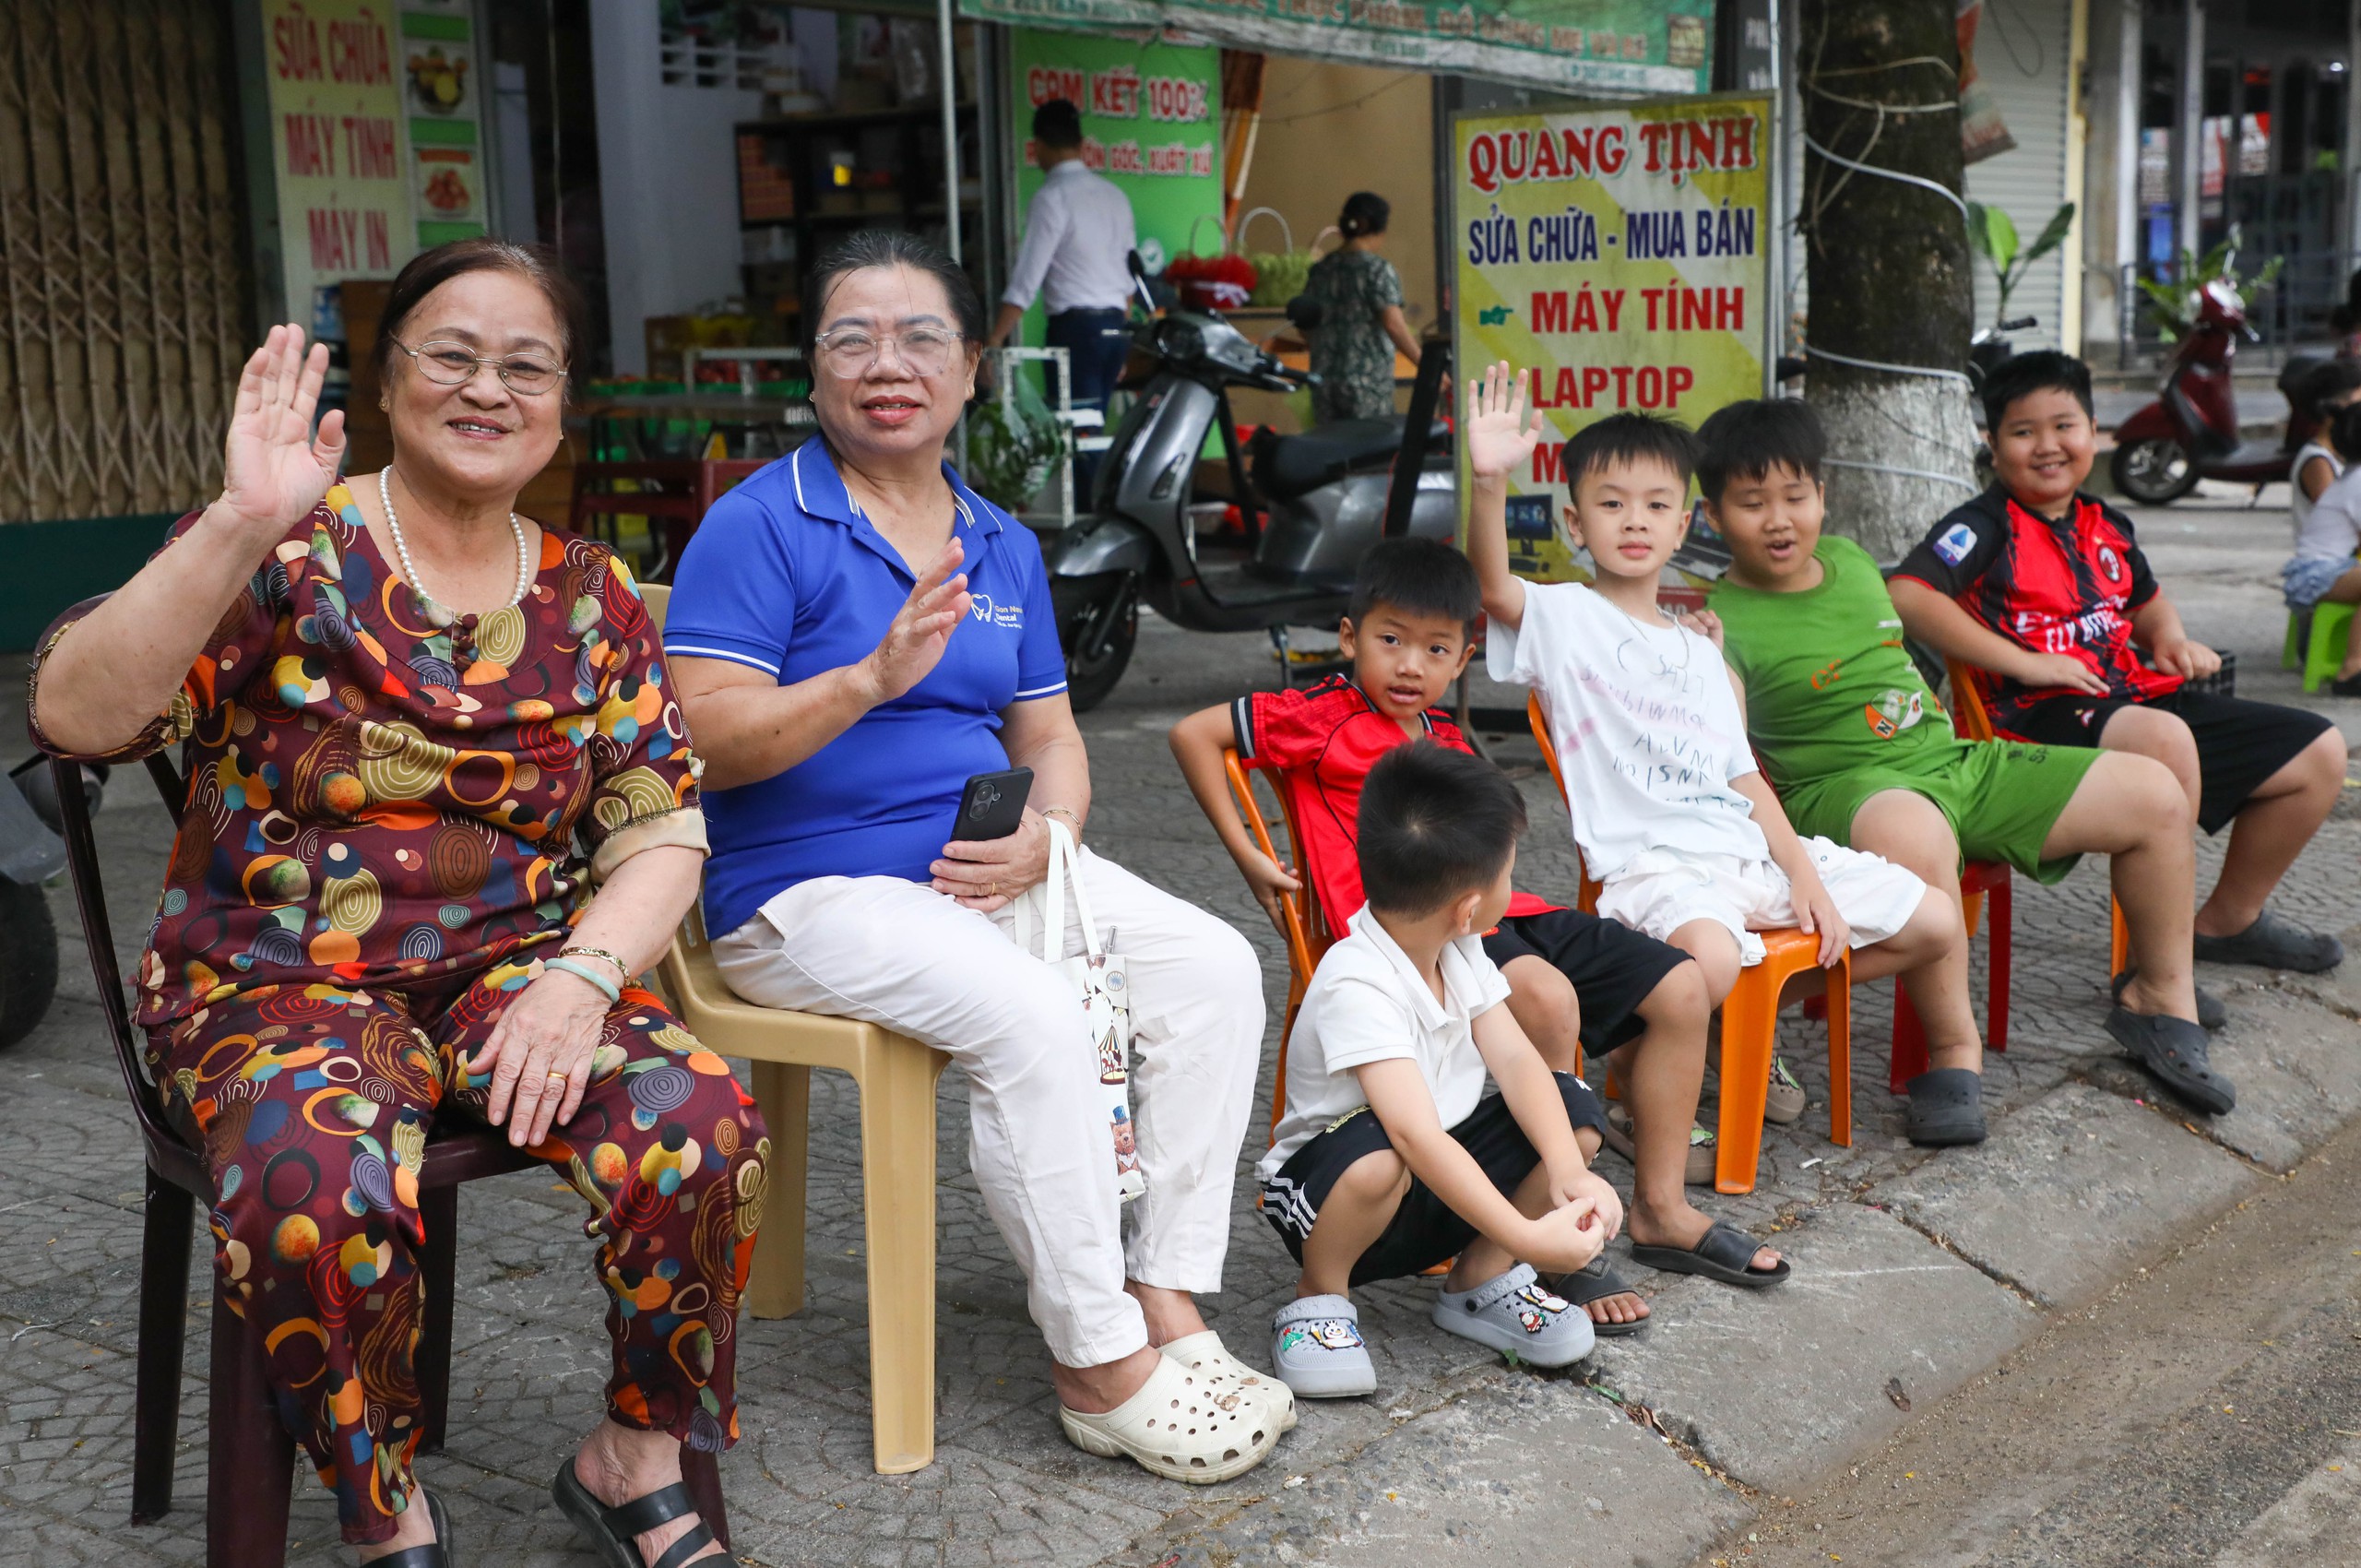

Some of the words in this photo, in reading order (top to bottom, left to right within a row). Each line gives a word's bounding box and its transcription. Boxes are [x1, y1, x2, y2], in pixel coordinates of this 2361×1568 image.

[1091, 65, 1140, 117] KẾT
[1467, 125, 1626, 191] QUANG
[1639, 115, 1758, 184] TỊNH
[1468, 204, 1519, 265] SỬA
[1527, 206, 1598, 262] CHỮA
[1626, 210, 1687, 260] MUA
[1695, 198, 1755, 257] BÁN
[1531, 281, 1626, 333] MÁY
[1641, 279, 1745, 331] TÍNH
[1531, 366, 1694, 410] LAPTOP
